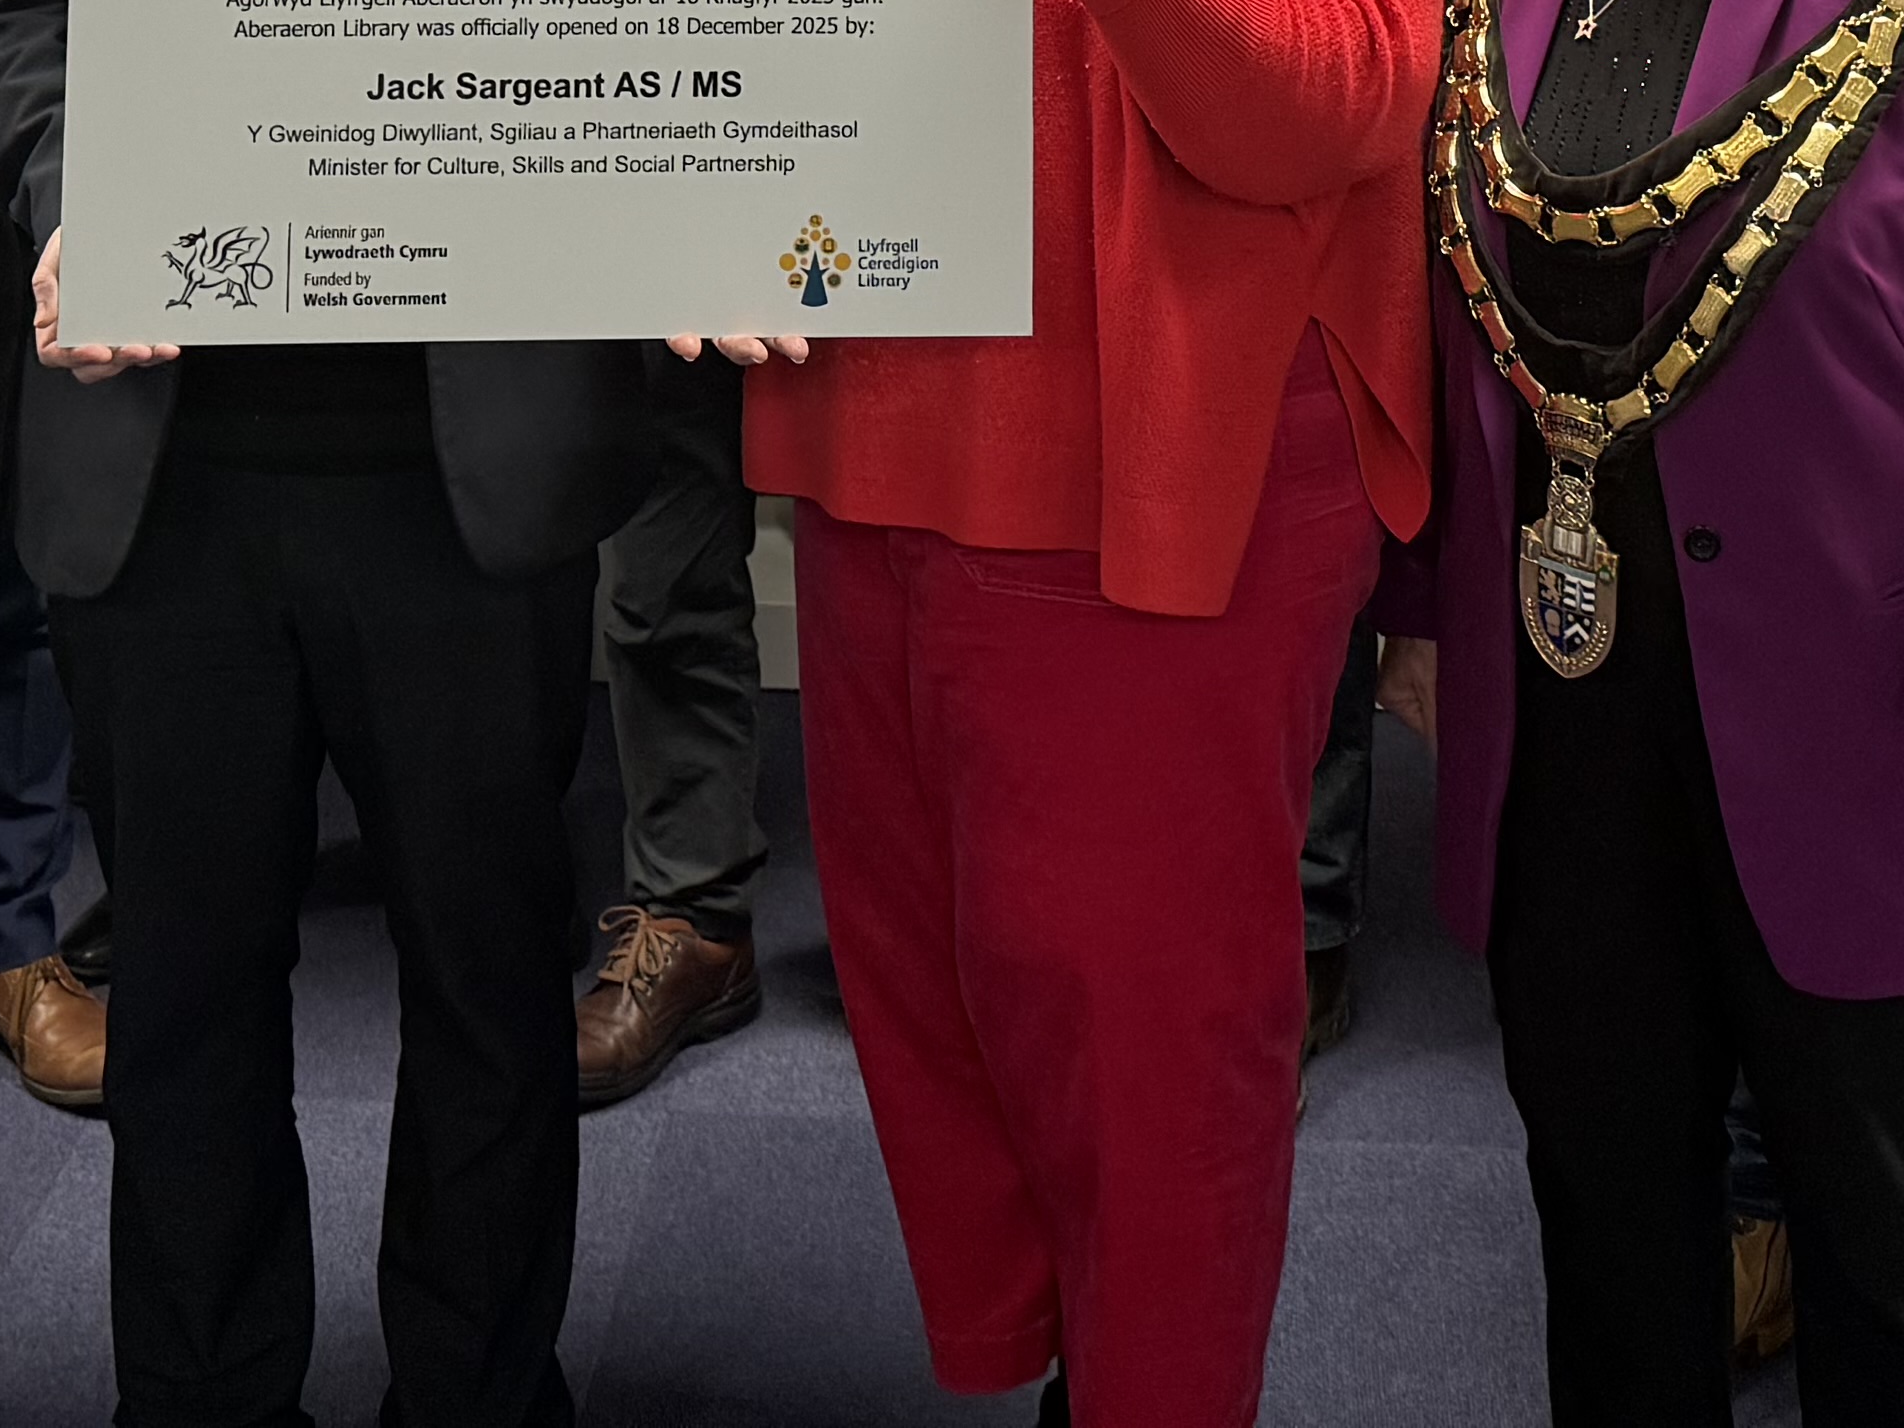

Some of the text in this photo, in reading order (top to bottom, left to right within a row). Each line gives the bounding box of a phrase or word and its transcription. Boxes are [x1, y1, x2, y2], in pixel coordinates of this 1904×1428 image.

[233, 15, 875, 41] Aberaeron Library was officially opened on 18 December 2025 by:
[366, 70, 742, 106] Jack Sargeant AS / MS
[247, 120, 858, 146] Y Gweinidog Diwylliant, Sgiliau a Phartneriaeth Gymdeithasol
[308, 153, 796, 177] Minister for Culture, Skills and Social Partnership
[304, 225, 385, 242] Ariennir gan
[304, 244, 448, 263] Lywodraeth Cymru
[858, 238, 919, 256] Llyfrgell
[858, 255, 939, 273] Ceredigion
[304, 271, 372, 289] Funded by
[858, 273, 911, 290] Library
[303, 292, 447, 307] Welsh Government
